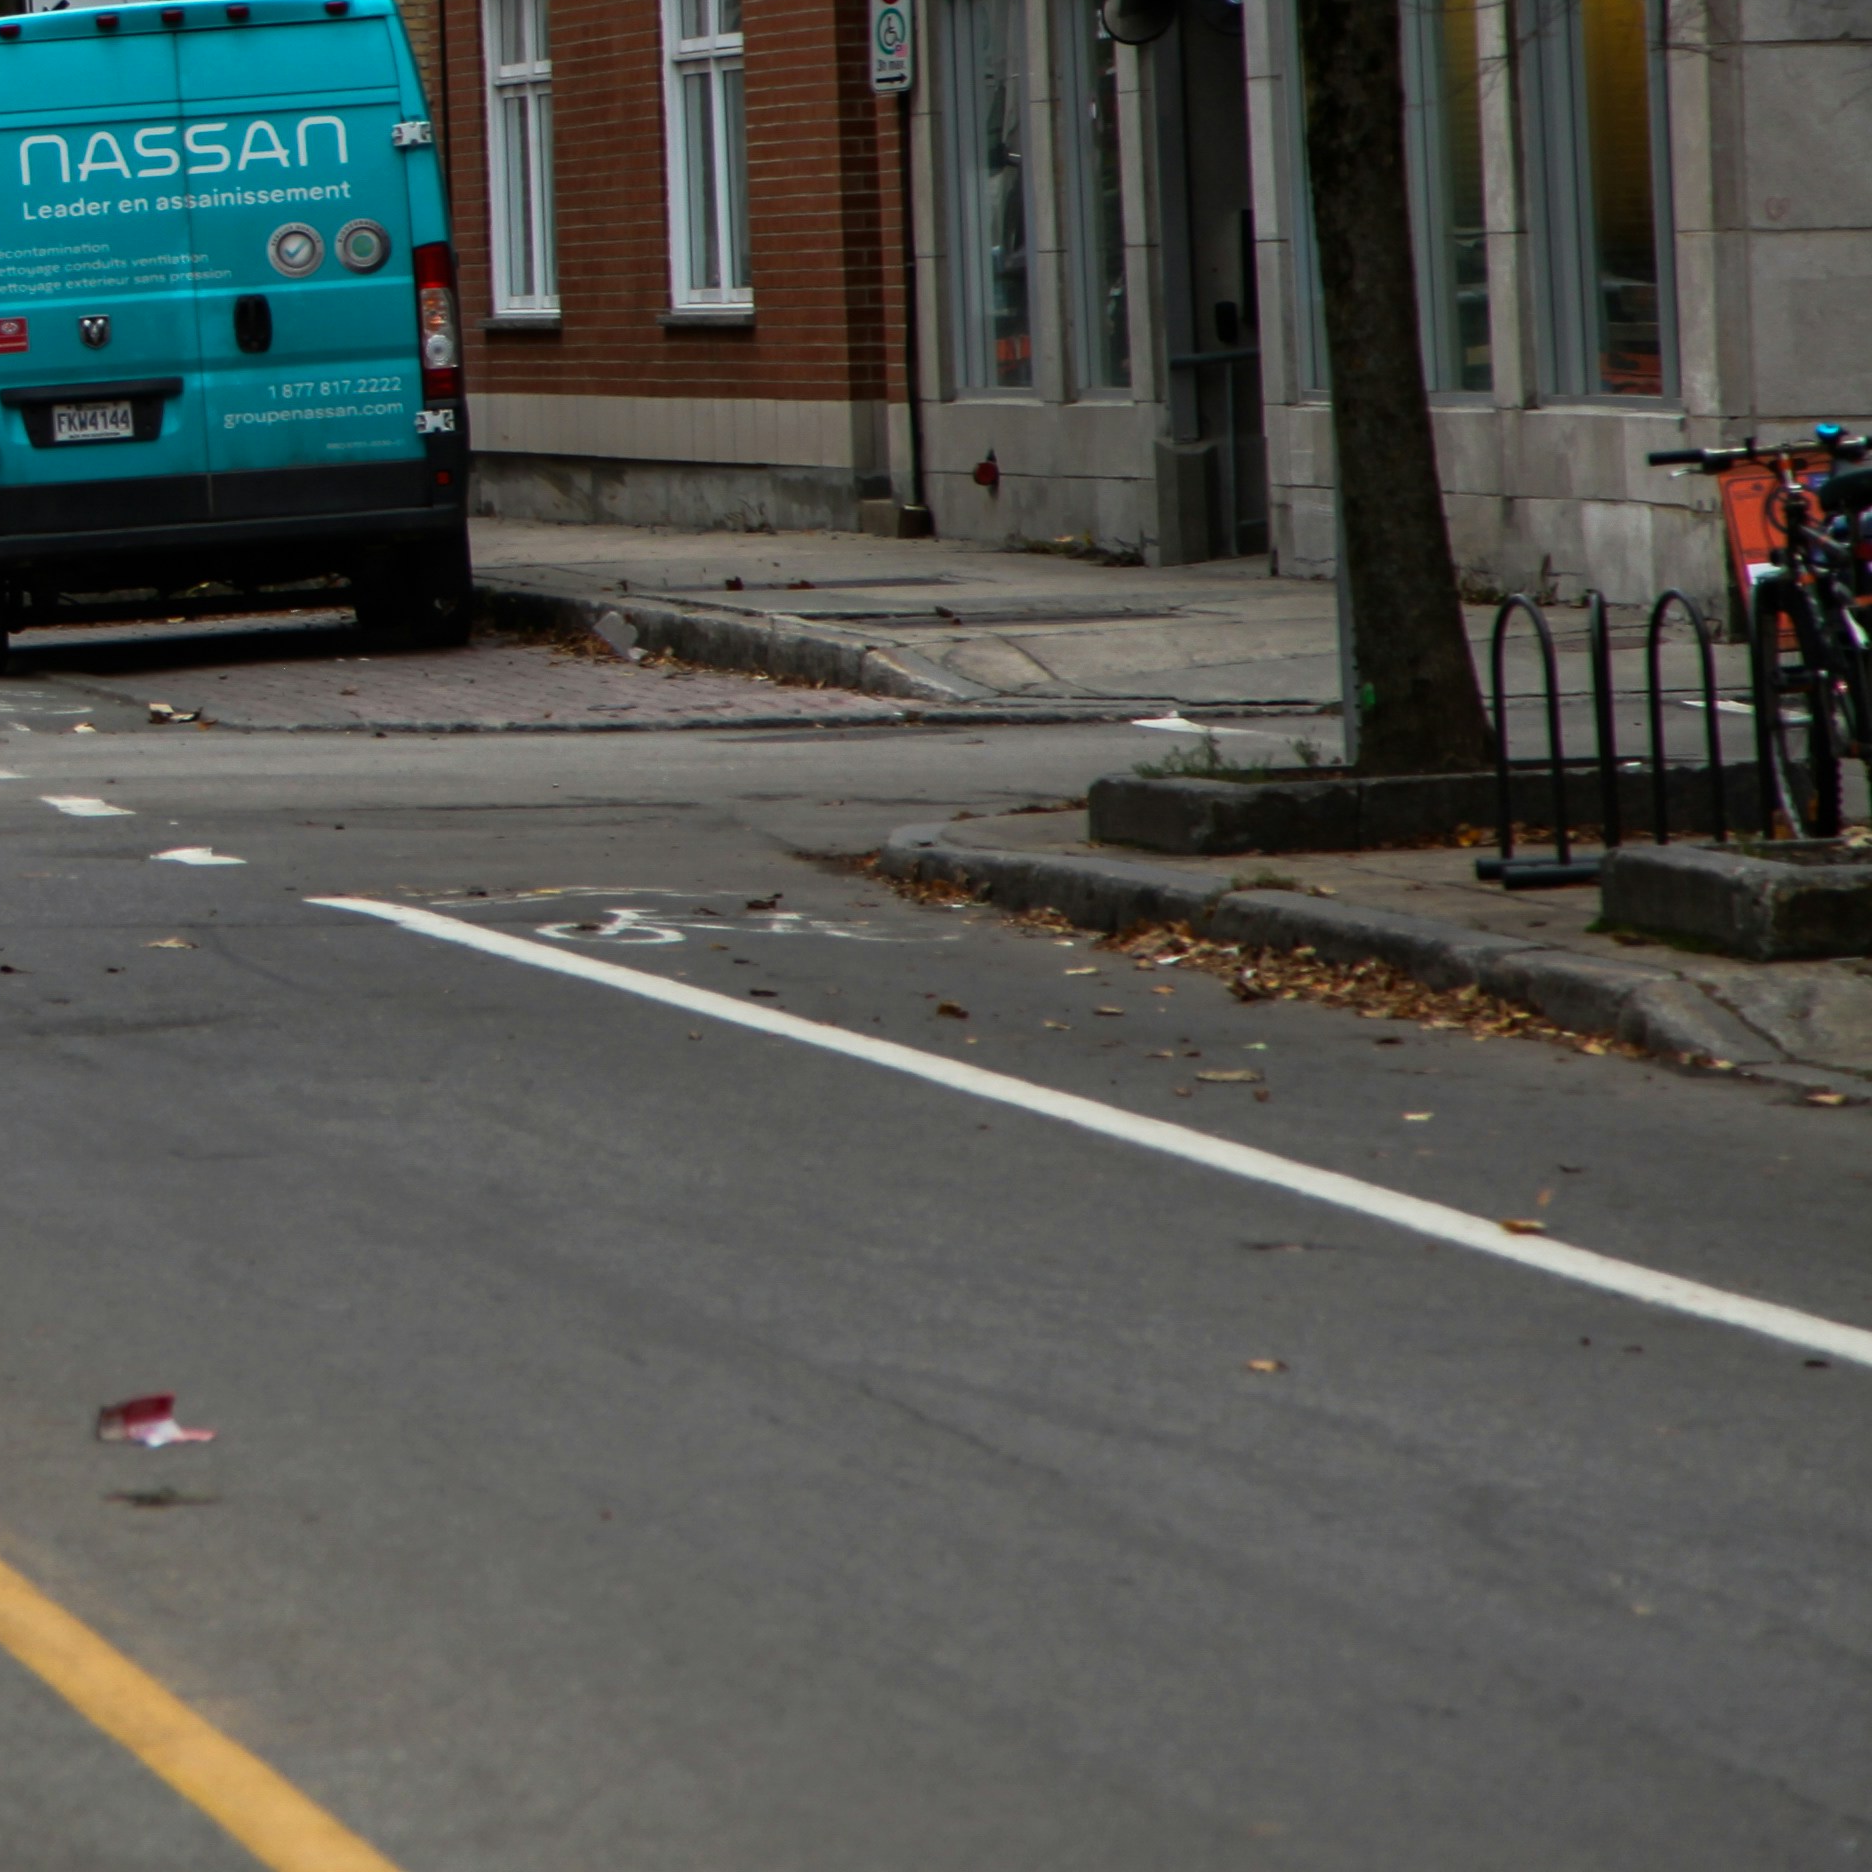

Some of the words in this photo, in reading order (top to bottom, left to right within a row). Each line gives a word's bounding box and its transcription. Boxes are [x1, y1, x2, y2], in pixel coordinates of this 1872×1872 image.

[19, 116, 349, 186] NASSAN
[23, 197, 110, 221] Leader
[119, 195, 148, 214] en
[156, 181, 352, 211] assainissement
[65, 259, 128, 273] conduits
[132, 252, 209, 267] ventilation
[134, 272, 165, 284] sans
[169, 267, 232, 283] pression
[267, 385, 277, 399] 1
[282, 381, 315, 398] 877
[320, 376, 402, 396] 817.2222
[223, 401, 404, 429] groupenassan.com
